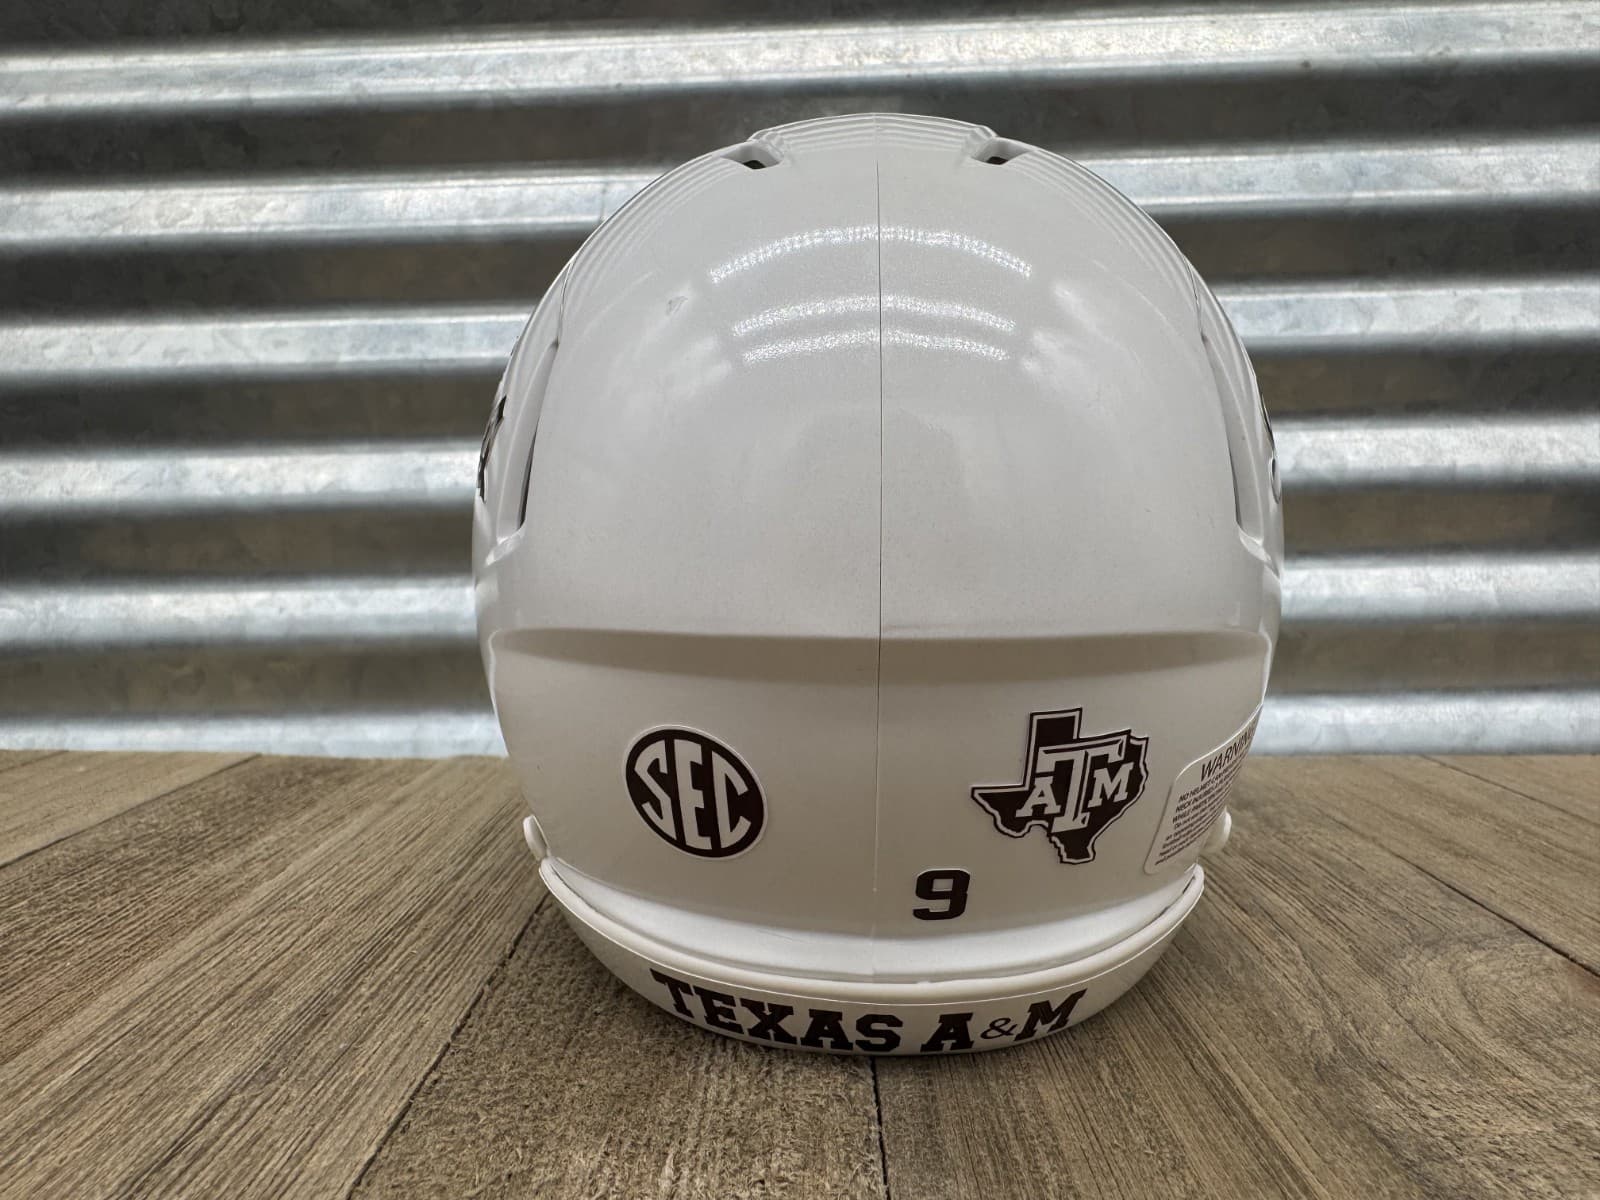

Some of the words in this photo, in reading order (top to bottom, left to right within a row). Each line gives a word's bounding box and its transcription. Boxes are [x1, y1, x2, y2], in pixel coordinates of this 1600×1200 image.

[633, 738, 752, 850] SEC
[912, 869, 970, 920] 9
[650, 968, 903, 1052] TEXAS
[920, 988, 1088, 1052] A&M
